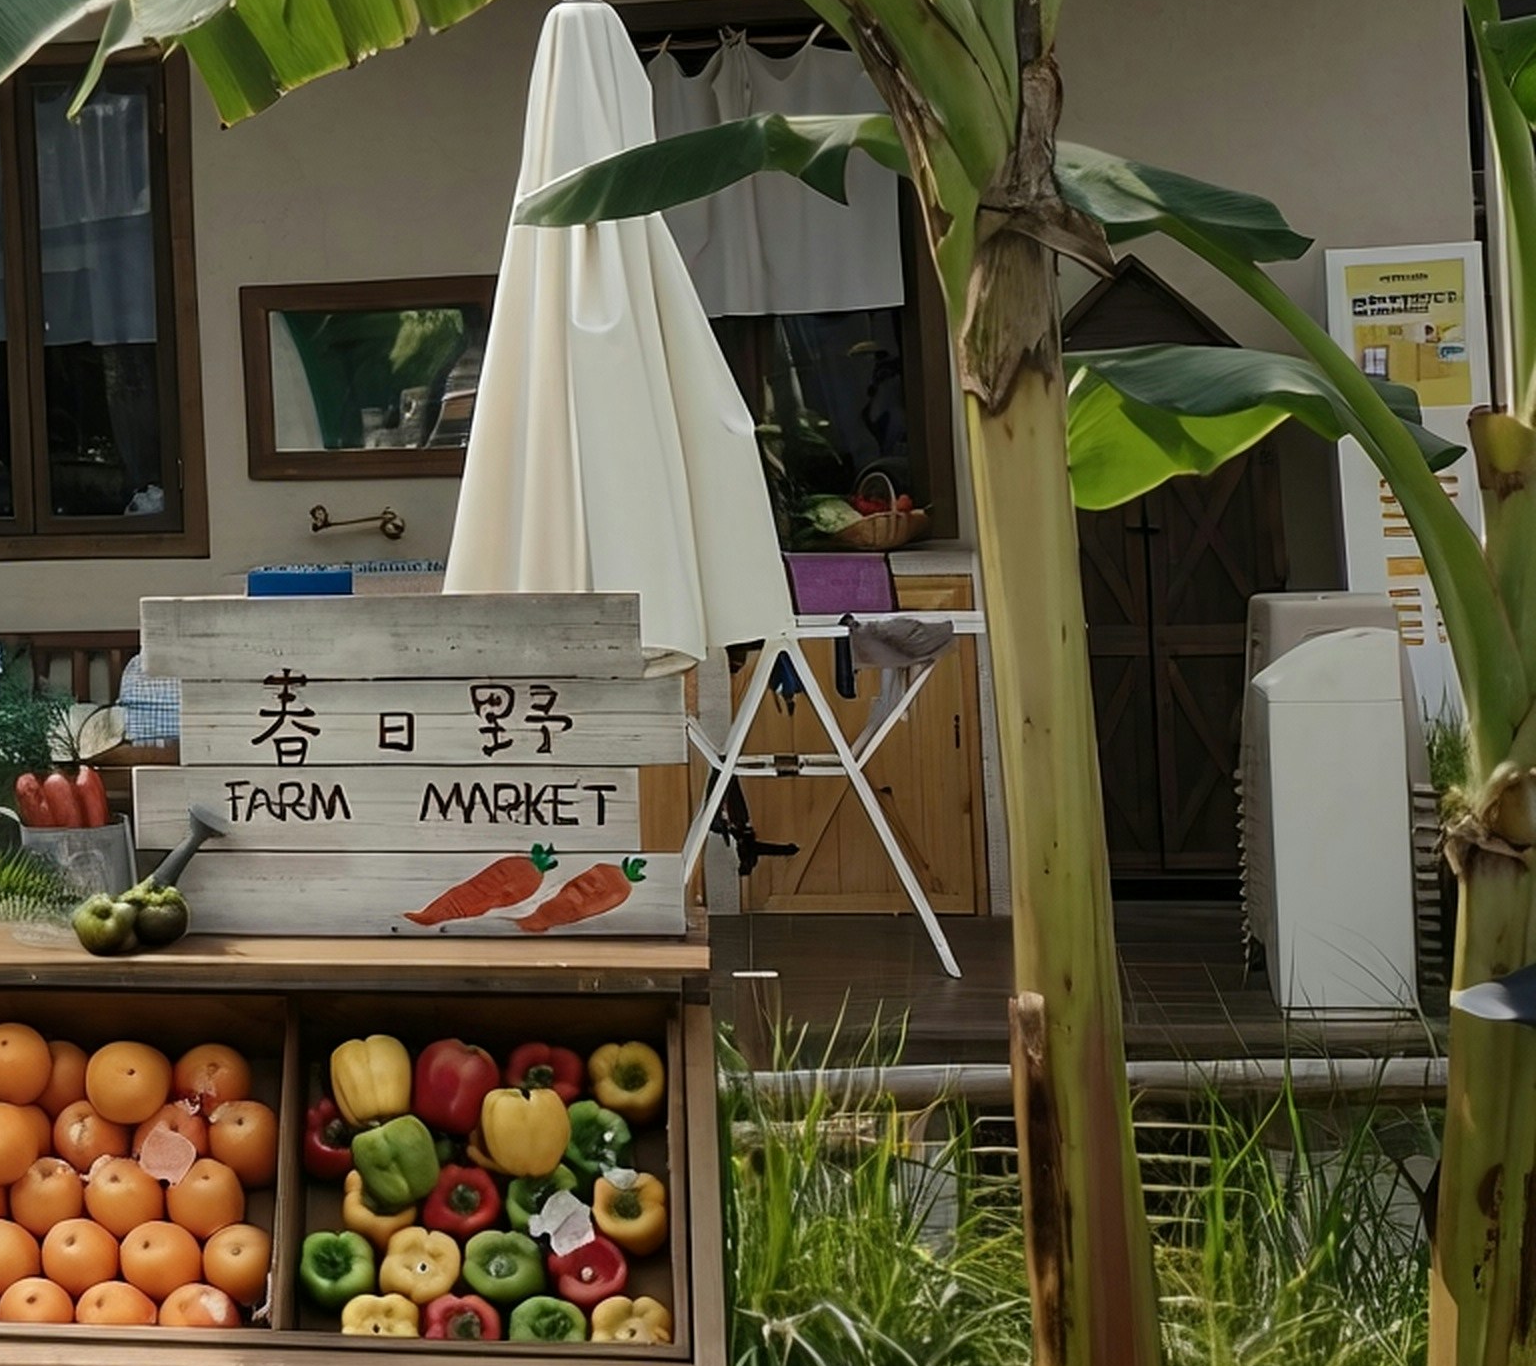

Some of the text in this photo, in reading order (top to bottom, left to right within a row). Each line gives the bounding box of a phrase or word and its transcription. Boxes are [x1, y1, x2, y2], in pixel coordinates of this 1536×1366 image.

[251, 668, 573, 766] 春日野
[224, 780, 618, 826] FARM MARKET
